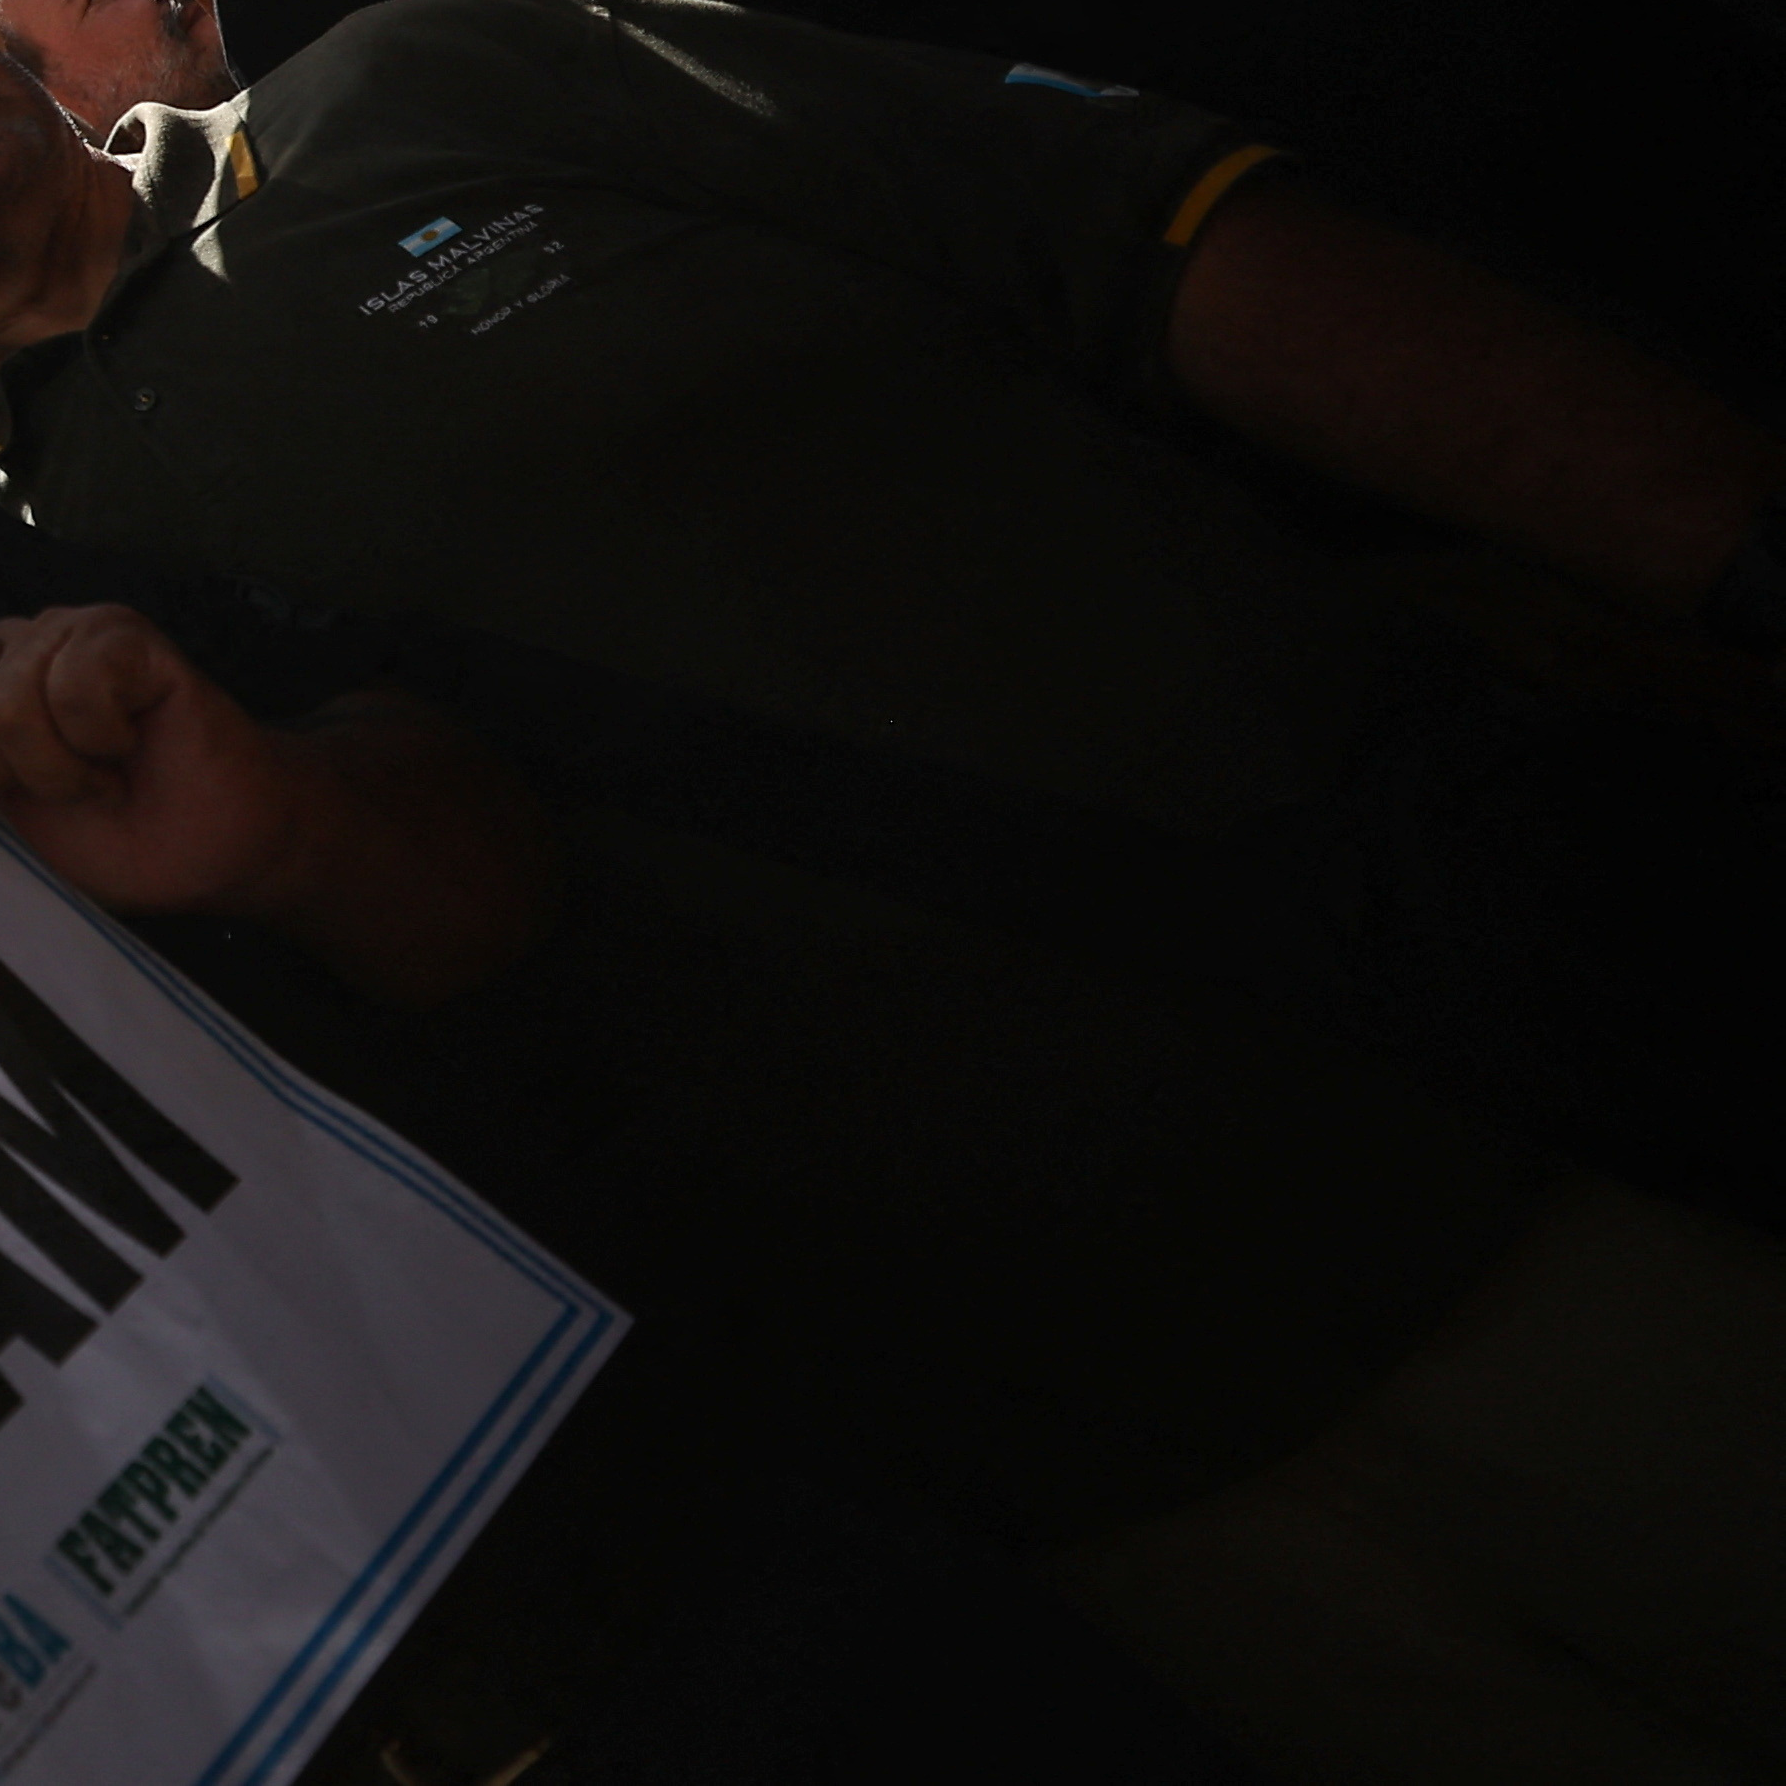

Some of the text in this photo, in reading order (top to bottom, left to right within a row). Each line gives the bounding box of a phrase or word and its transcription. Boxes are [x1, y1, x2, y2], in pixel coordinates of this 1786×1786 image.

[358, 203, 544, 316] ISLAS MALVINAS
[466, 220, 539, 265] ARGENTINA
[56, 1386, 250, 1596] FATPREN
